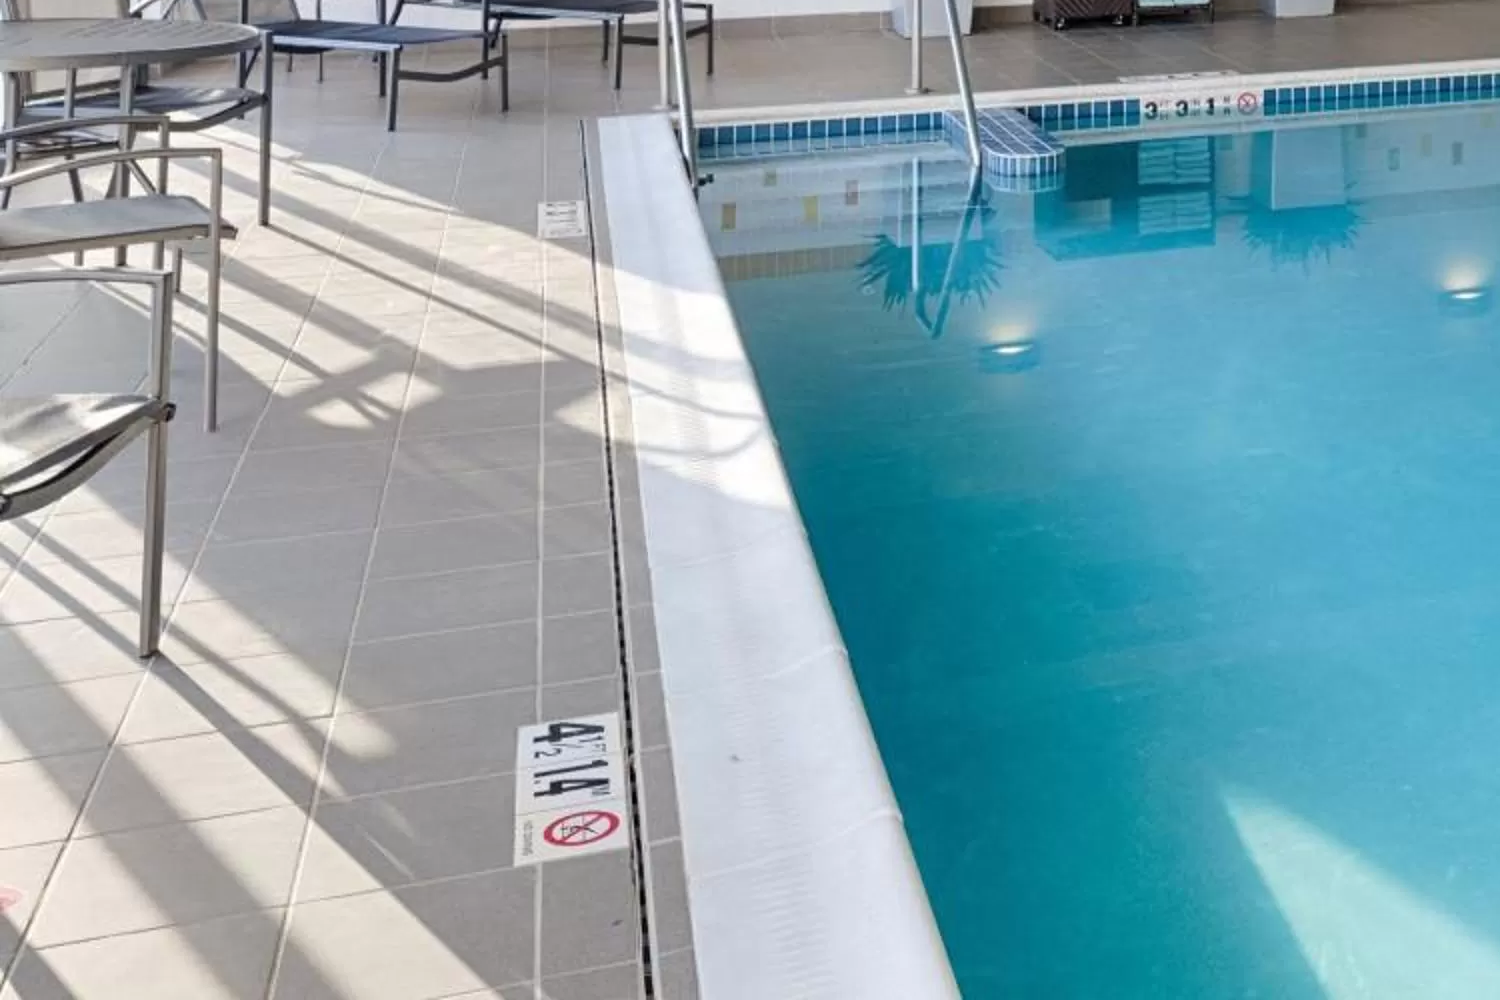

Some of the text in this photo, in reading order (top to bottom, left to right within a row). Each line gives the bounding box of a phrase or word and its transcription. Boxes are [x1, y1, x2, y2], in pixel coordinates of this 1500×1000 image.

[1145, 101, 1158, 120] 3
[1175, 100, 1188, 117] 3
[1205, 97, 1214, 116] 1
